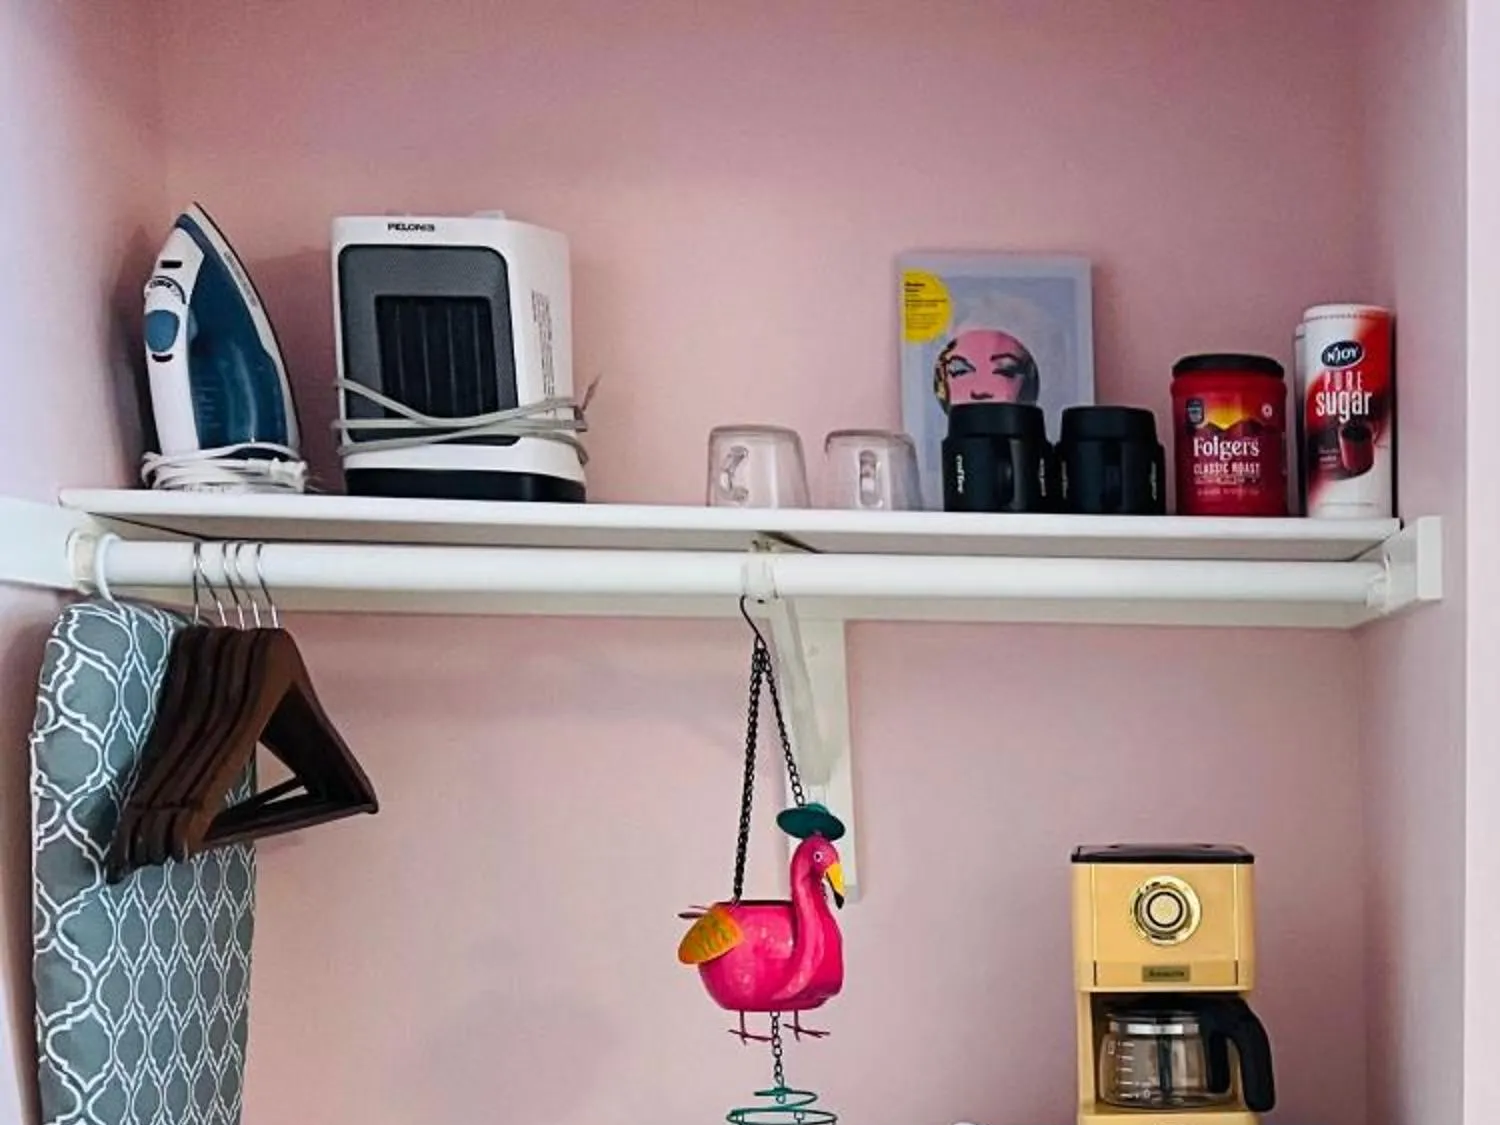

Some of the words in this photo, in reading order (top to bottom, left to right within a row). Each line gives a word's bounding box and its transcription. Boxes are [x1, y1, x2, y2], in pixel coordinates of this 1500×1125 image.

[1324, 370, 1363, 391] PURE
[1315, 391, 1373, 424] sugar
[1193, 435, 1260, 461] Folgers
[1193, 462, 1229, 475] CLASSIC
[1231, 462, 1260, 476] ROAST
